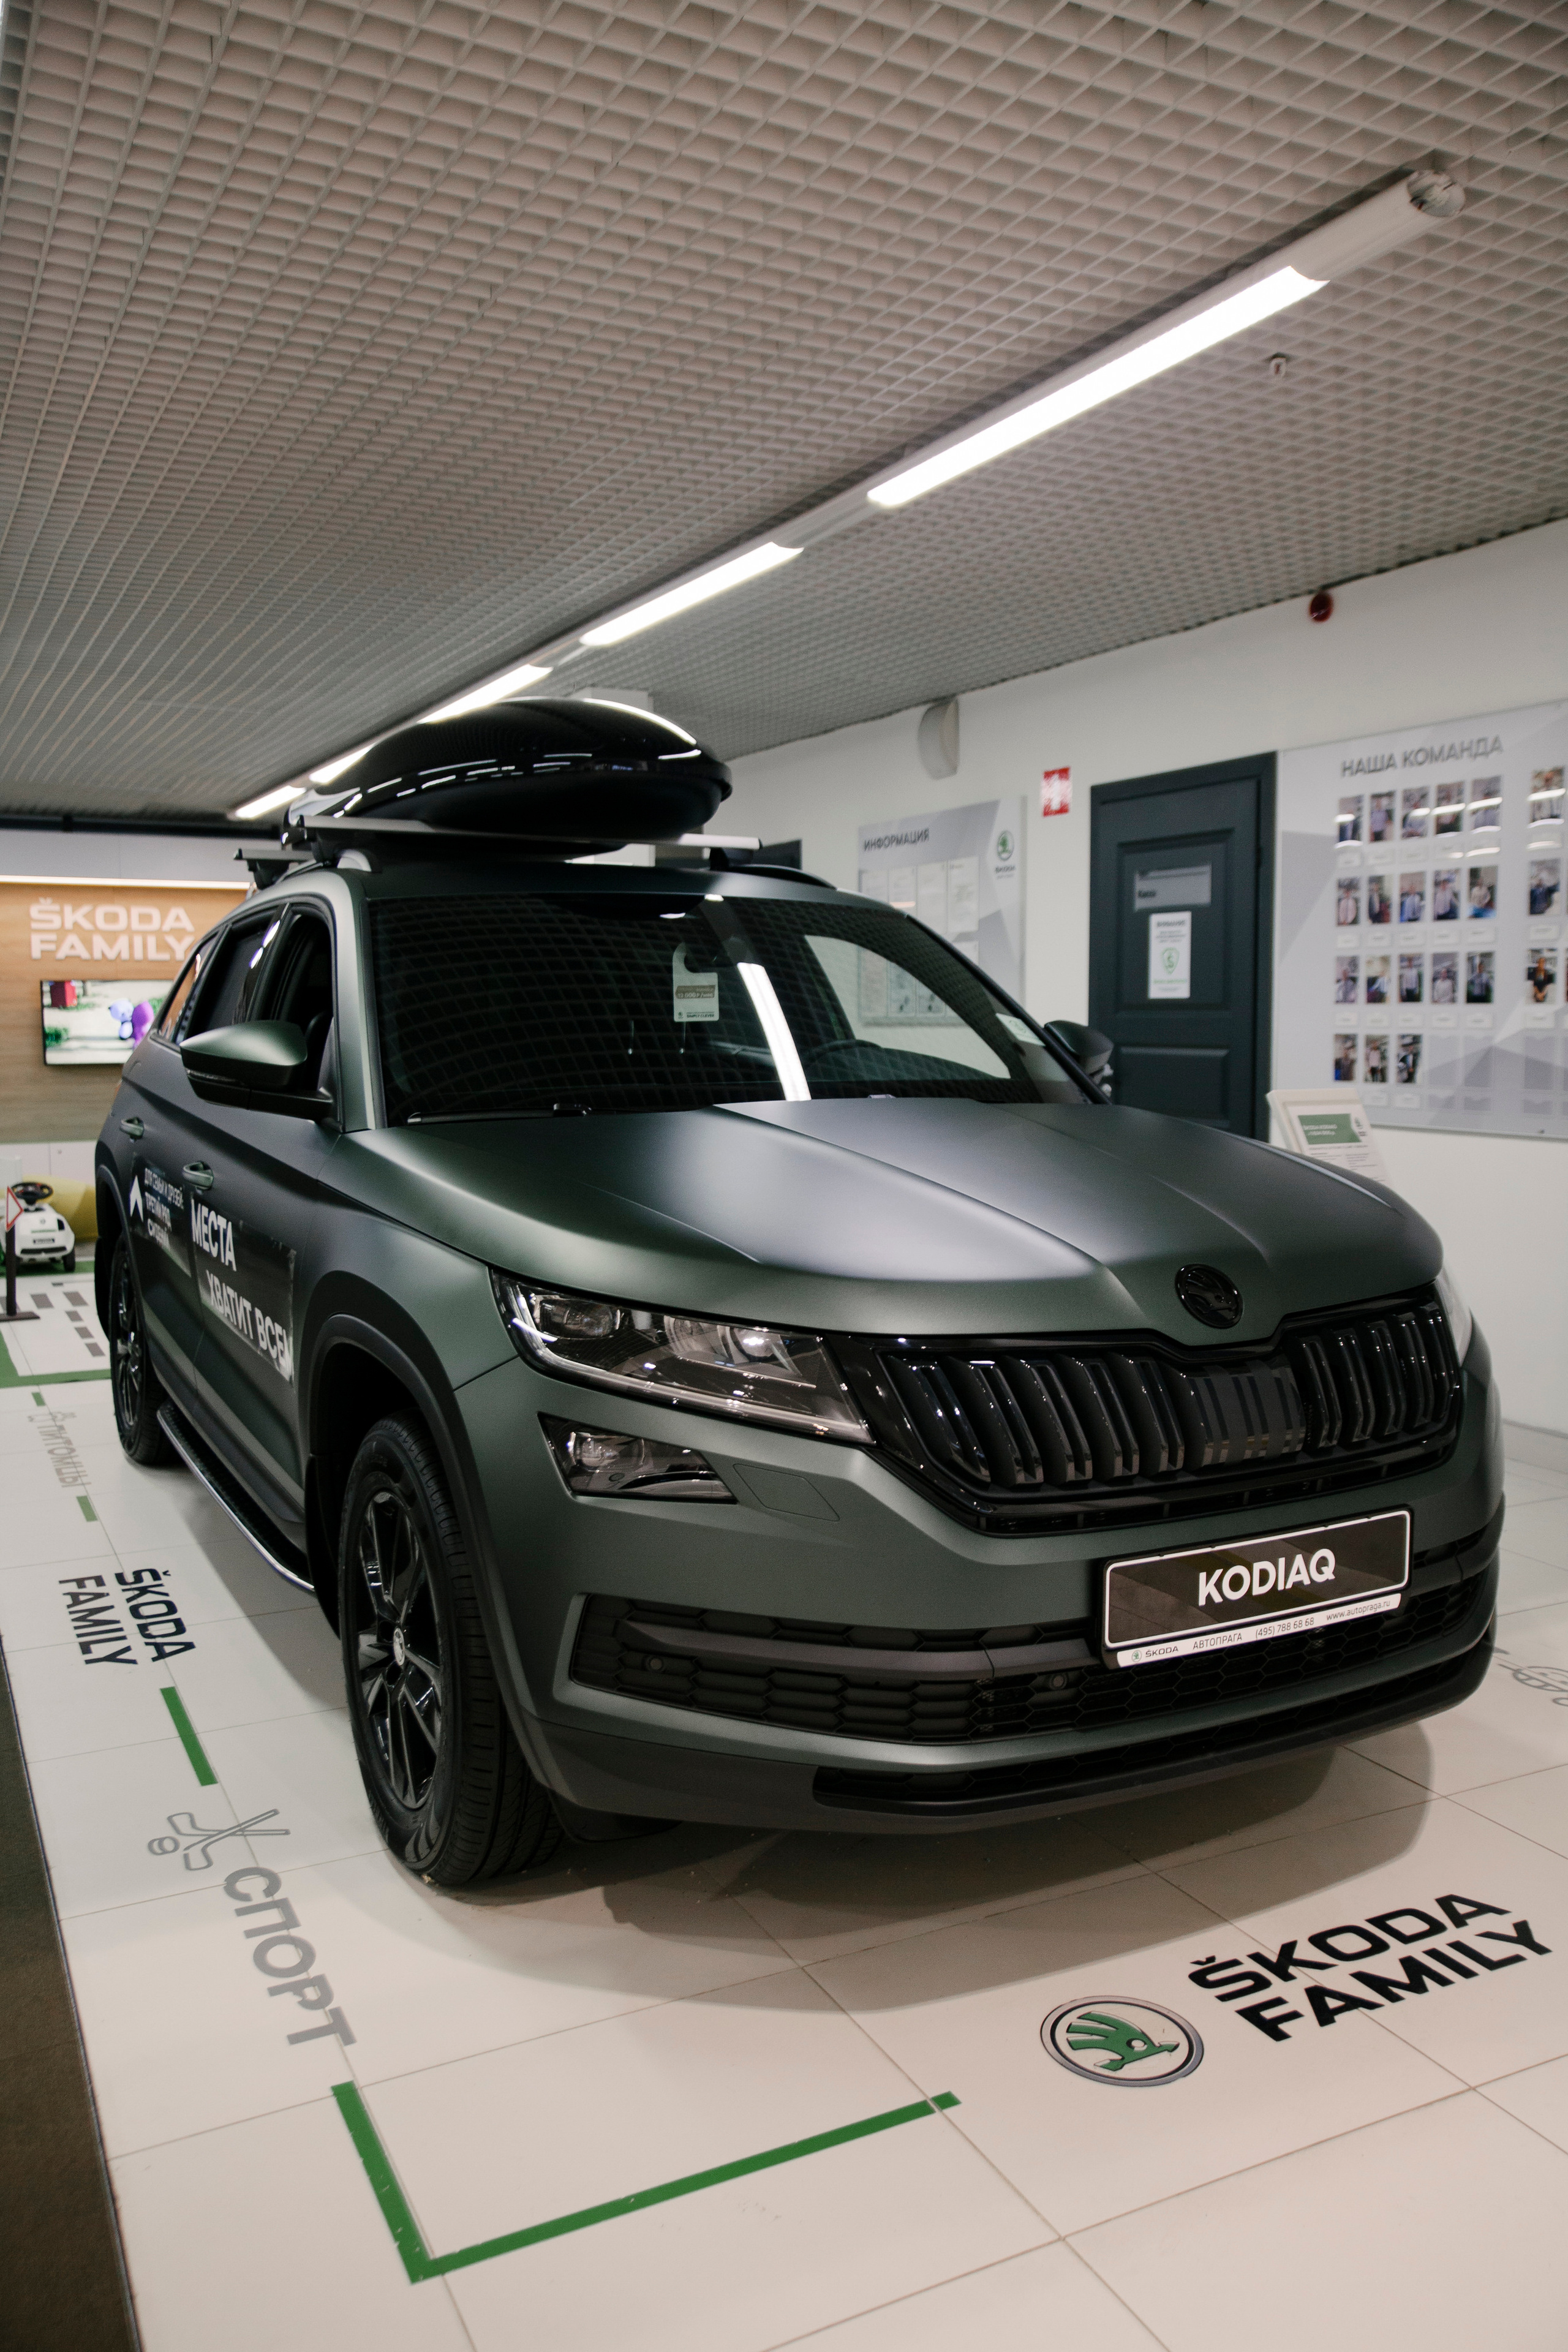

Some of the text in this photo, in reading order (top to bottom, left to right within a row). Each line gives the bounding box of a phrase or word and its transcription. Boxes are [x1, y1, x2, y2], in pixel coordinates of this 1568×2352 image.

[1341, 735, 1504, 778] НАША КОМАНДА
[864, 828, 930, 851] ИНФОРМАЦИЯ
[30, 897, 195, 932] ŠKODA
[31, 932, 195, 961] FAMILY
[191, 1198, 236, 1272] МЕСТА
[206, 1270, 253, 1340] ХВАТИТ
[37, 1424, 92, 1488] ПИТОМЦЫ
[1199, 1548, 1336, 1607] KODIAQ
[59, 1575, 138, 1665] FAMILY
[115, 1568, 196, 1662] ŠKODA
[1145, 1599, 1391, 1658] ŠKODA АВТОПРАГА (495) 788 68 68 www.autopraga.ru
[224, 1866, 357, 2046] СПОРТ
[1188, 1893, 1512, 2002] ŠKODA
[1235, 1920, 1553, 2042] FAMILY
